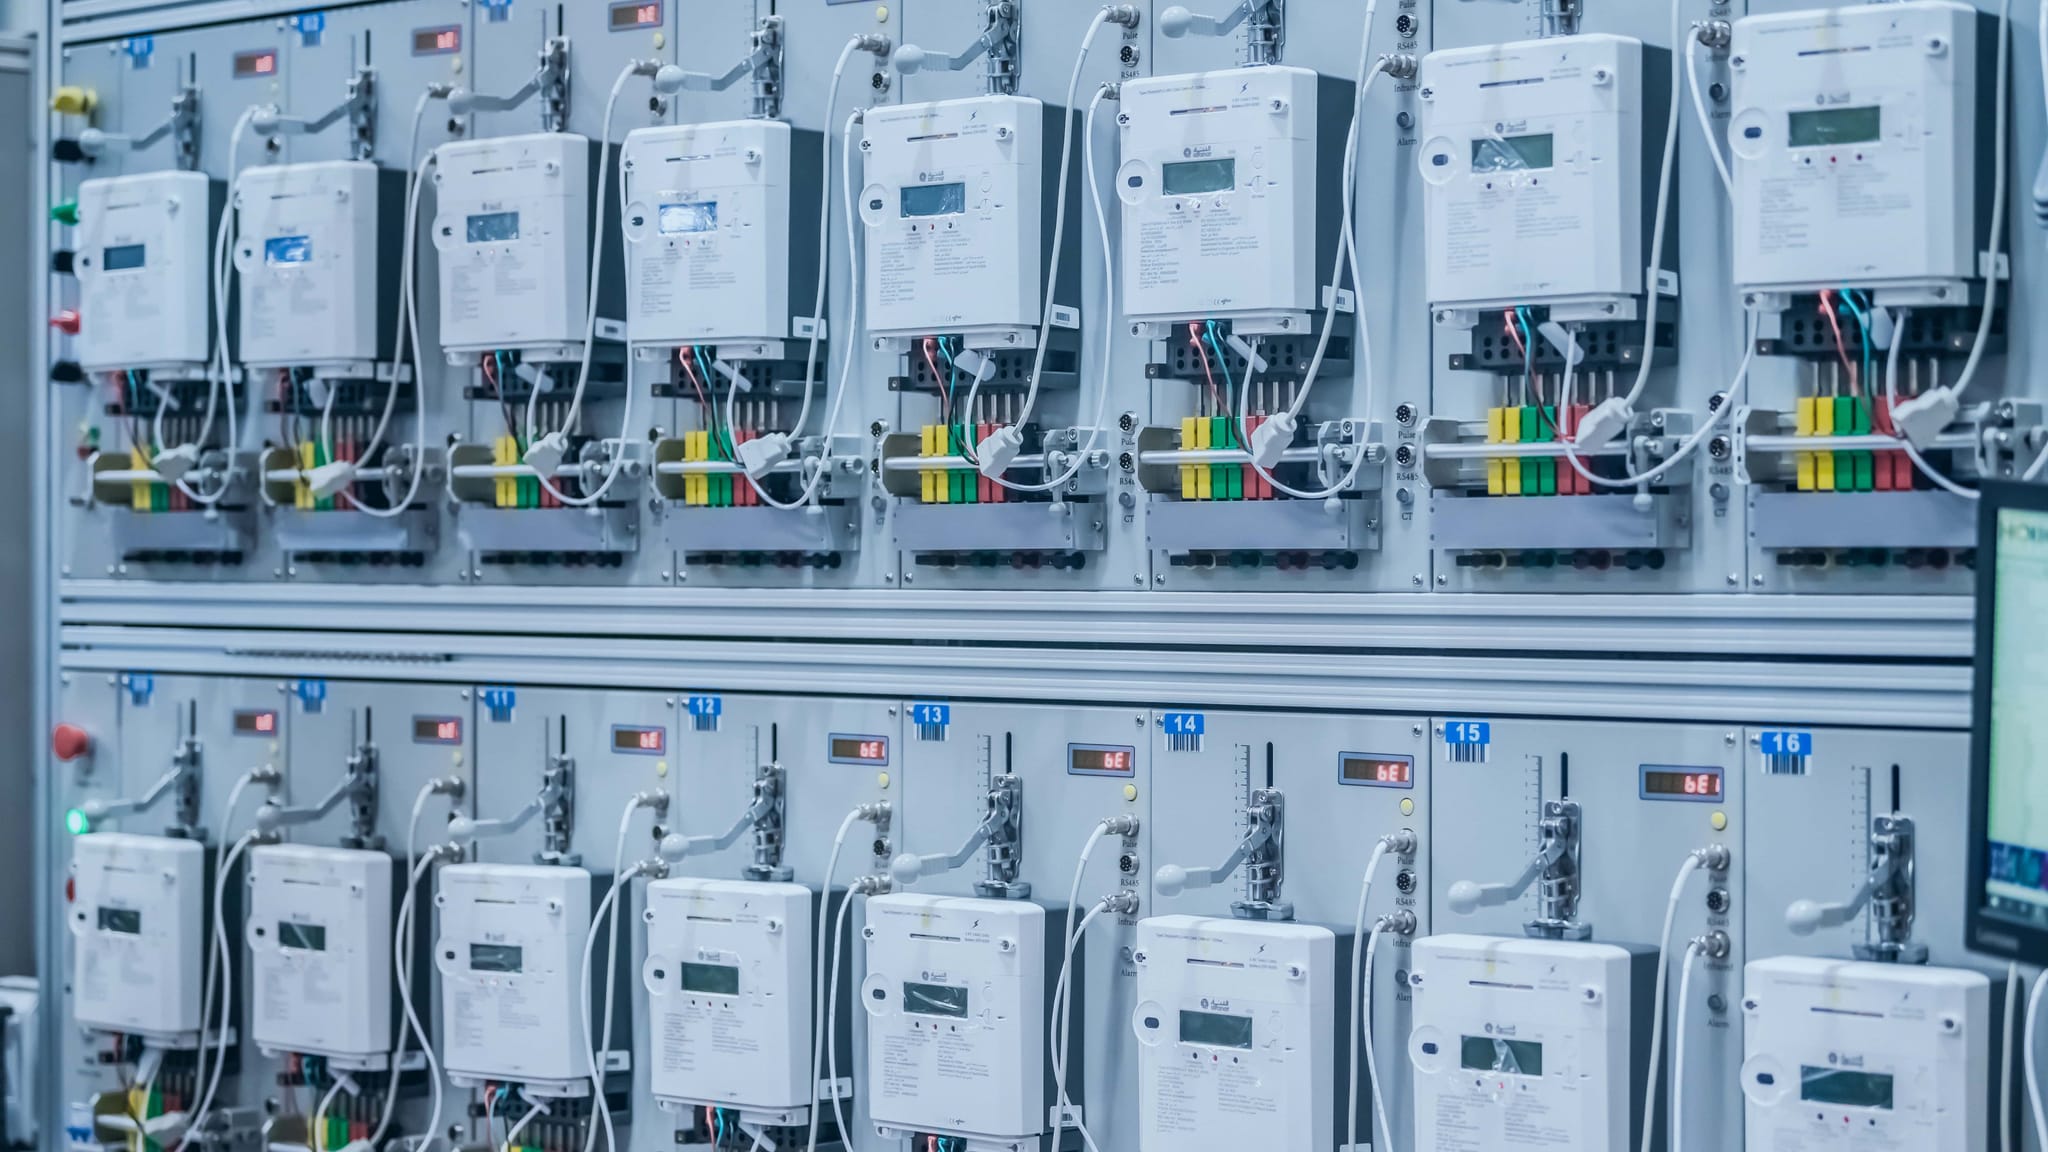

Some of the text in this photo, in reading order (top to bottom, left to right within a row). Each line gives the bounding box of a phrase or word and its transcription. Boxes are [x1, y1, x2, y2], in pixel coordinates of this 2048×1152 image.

[1397, 41, 1418, 50] RS485
[1398, 430, 1416, 439] Pulse
[1396, 472, 1419, 481] RS485
[1123, 515, 1134, 523] CT
[1401, 512, 1413, 520] CT
[493, 691, 507, 706] 11
[696, 699, 714, 714] 12
[922, 706, 942, 723] 13
[1174, 715, 1196, 732] 14
[1456, 723, 1480, 742] 15
[1773, 734, 1800, 753] 16
[1397, 856, 1414, 865] Pulse
[1120, 879, 1140, 887] RS485
[1395, 897, 1416, 906] RS485
